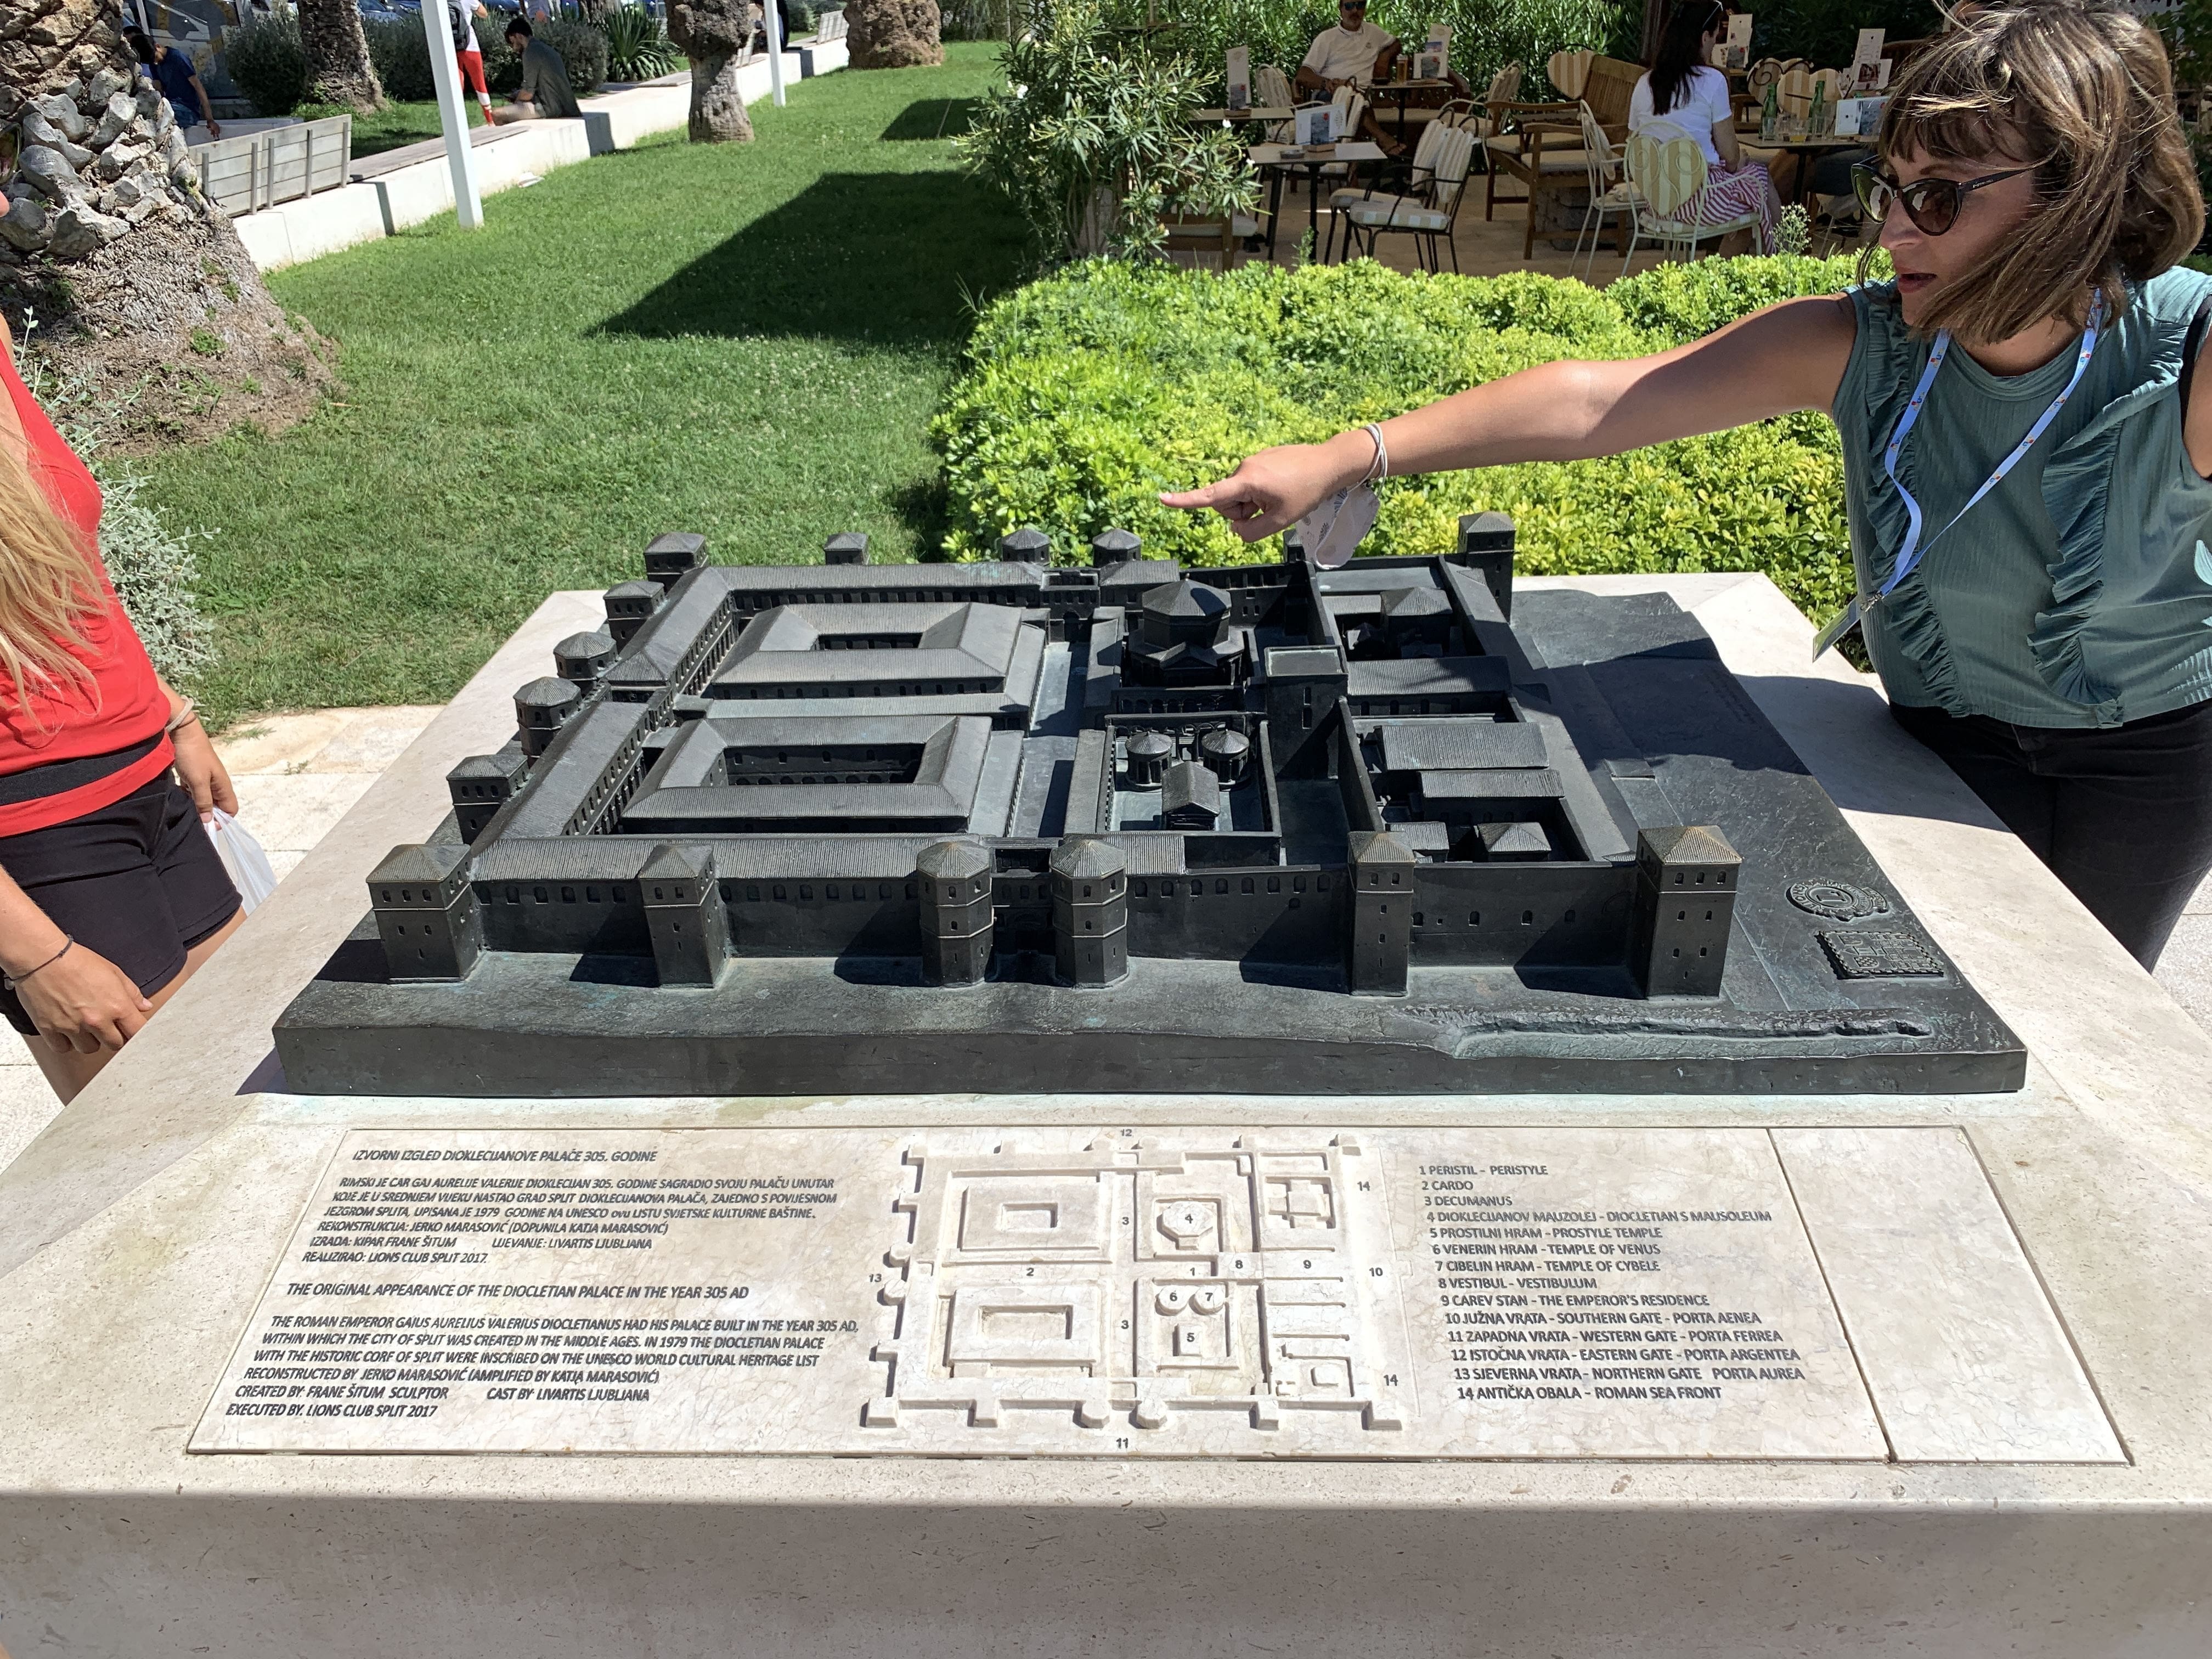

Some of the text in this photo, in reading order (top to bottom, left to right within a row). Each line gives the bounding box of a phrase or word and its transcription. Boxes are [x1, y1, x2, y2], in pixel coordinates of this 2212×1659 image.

[1792, 884, 1818, 909] LIONS
[1120, 1128, 1132, 1137] 12
[352, 1150, 400, 1160] IZVORNI
[400, 1150, 442, 1161] IZGLED
[611, 1150, 658, 1162] GODINE
[1419, 1164, 1549, 1175] 1 PERISTIL PERISTYLE
[1357, 1181, 1370, 1192] 14
[1421, 1179, 1474, 1192] 2 CARDO
[1423, 1195, 1514, 1207] 3 DECUMANUS
[1122, 1216, 1130, 1226] 3
[1184, 1214, 1193, 1224] 4
[1427, 1212, 1436, 1223] 4
[1532, 1211, 1597, 1223] MAUZOLEJ
[1690, 1211, 1772, 1222] MAUSOLEUM
[1430, 1227, 1663, 1239] 5 PROSTILNI HRAM PROSTYLE TEMPLE
[546, 1238, 594, 1249] LIVARTIS
[595, 1237, 652, 1250] LJUBLJANA
[1432, 1243, 1663, 1256] 6 VENERIN HRAM TEMPLE OF VENUS
[301, 1251, 488, 1264] REALIZIRAO: LIONS CLUB SPLIT 2017.
[1235, 1260, 1243, 1269] 8
[1303, 1260, 1312, 1269] 9
[1435, 1259, 1661, 1273] 7 CIBELIN HRAM TEMPLE OF CYBELE
[869, 1273, 882, 1283] 13
[1026, 1267, 1034, 1277] 2
[1189, 1267, 1195, 1277] 1
[1369, 1267, 1383, 1277] 10
[1437, 1276, 1600, 1291] 8 VESTIBUL VESTIBULUM
[286, 1283, 749, 1300] THE ORIGINAL APPEARANCE OF THE DIOCLETIAN PALACE IN THE YEAR 305 AD
[1169, 1292, 1178, 1302] 6
[1205, 1292, 1214, 1302] 7
[1440, 1294, 1710, 1308] 9 CAREV STAN THE EMPEROR'S RESIDENCE
[271, 1316, 859, 1333] THE ROMAN EMPEROR GAIUS AURELIUS VALERIUS DIOCLETIANUS HAD HIS PALACE BUILT IN THE YEAR 305 AD,
[1121, 1319, 1129, 1330] 3
[1445, 1311, 1762, 1326] 10 JUŽNA VRATA SOUTHERN GATE PORTA AENEA
[262, 1333, 825, 1350] WITHIN WHICH THE CITY OF SPLIT WAS CREATED IN THE MIDDLE AGES. IN 1979 THE DIOCLETIAN PALACE
[1187, 1332, 1195, 1342] 5
[1448, 1329, 1784, 1344] 11 ZAPADNA VRATA WESTERN GATE PORTA FERREA
[1452, 1346, 1801, 1363] 12 ISTOČNA VRATA EASTERN GATE PORTA ARGENTEA
[1383, 1374, 1398, 1386] 14
[1454, 1367, 1807, 1381] 13 SJEVERNA VRATA NORTHERN GATE PORTA AUREA
[1457, 1384, 1722, 1401] 14 ANTIČKA OBALA ROMAN SEA FRONT
[1116, 1437, 1128, 1449] 11
